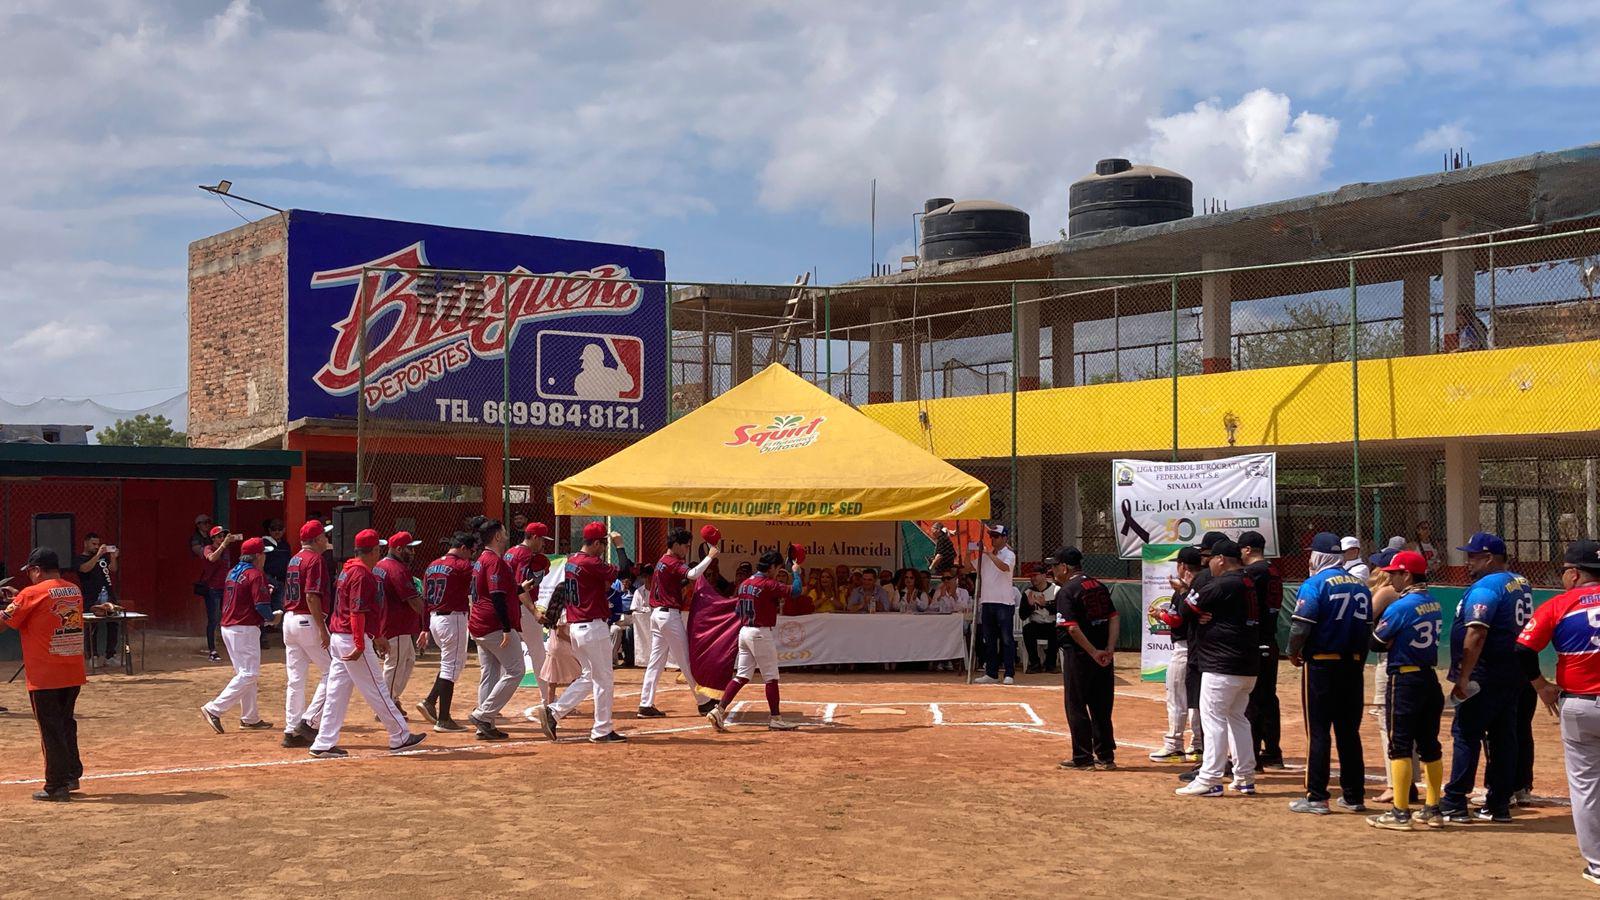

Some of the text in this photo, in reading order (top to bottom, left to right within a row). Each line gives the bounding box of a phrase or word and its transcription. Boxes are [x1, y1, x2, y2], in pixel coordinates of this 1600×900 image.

[365, 342, 471, 411] DEPORTES
[436, 399, 479, 424] TEL.
[724, 416, 825, 448] Squirt
[1136, 465, 1153, 473] LIGA
[1153, 465, 1164, 473] DE
[1164, 464, 1195, 472] BEISBOL
[1156, 473, 1188, 481] FEDERAL
[672, 501, 863, 516] QUITA CUALQUIER TIPO DE SED
[1135, 497, 1268, 514] Lic. Joel Ayala Almeida
[1166, 517, 1257, 542] 50 ANIVERSARIO
[721, 539, 747, 554] Lic.
[751, 540, 780, 556] Joel
[829, 541, 891, 556] Almeida
[427, 577, 447, 605] 27
[1329, 592, 1369, 620] 73
[1515, 592, 1534, 626] 63
[1409, 619, 1443, 649] 35
